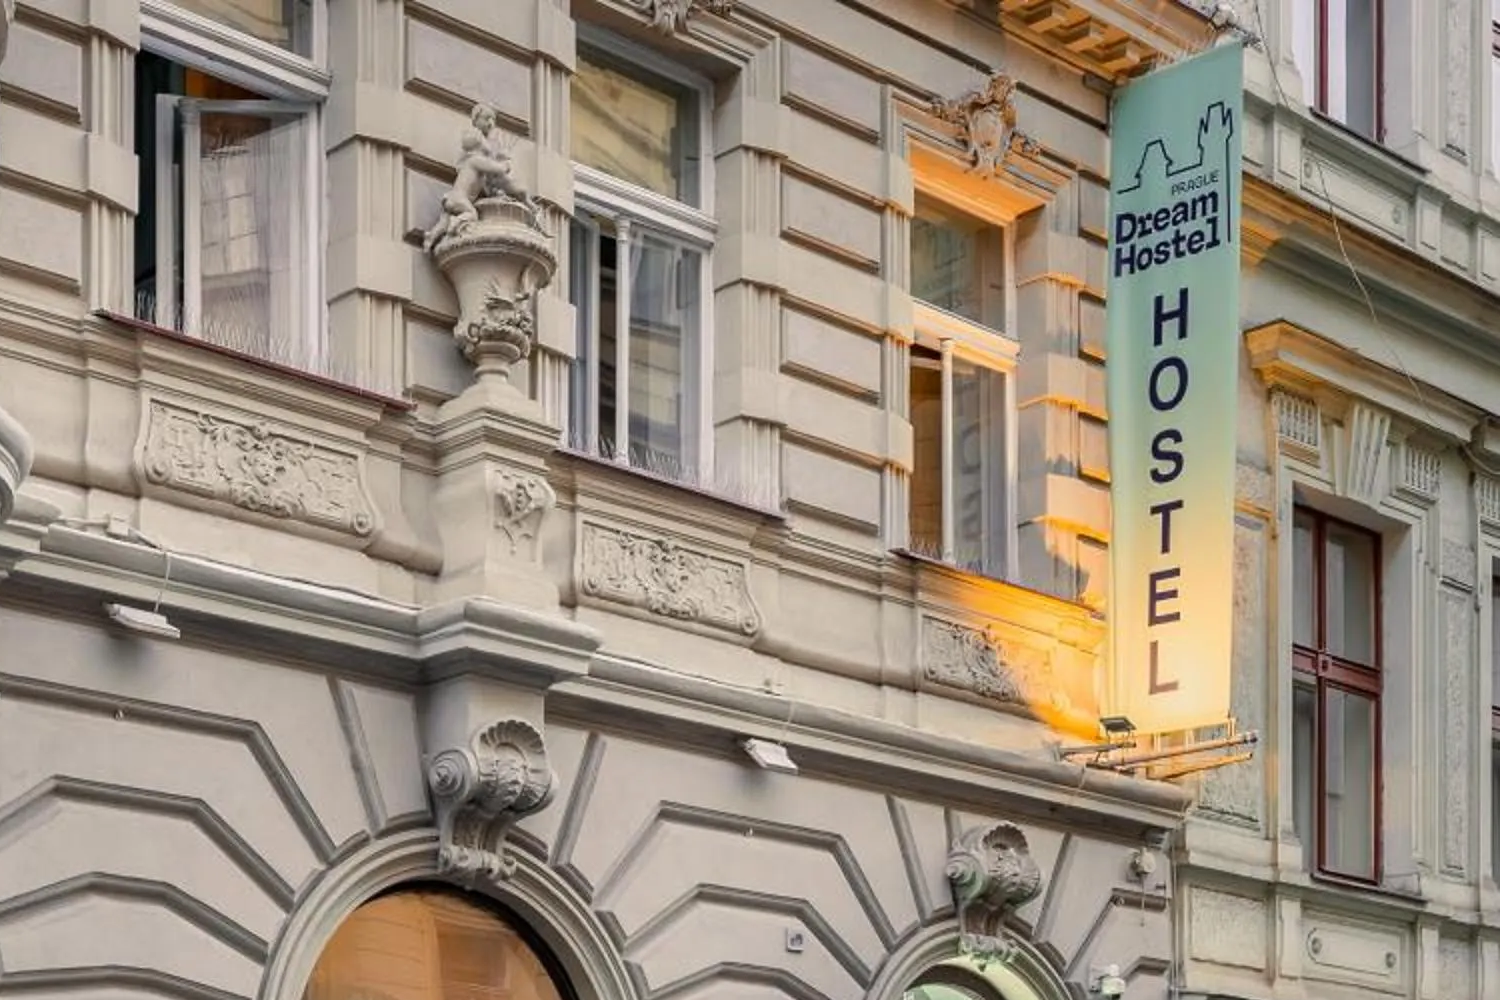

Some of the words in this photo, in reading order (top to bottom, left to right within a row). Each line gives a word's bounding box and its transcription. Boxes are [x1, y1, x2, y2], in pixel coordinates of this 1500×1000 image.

[1114, 216, 1221, 277] Hostel
[1116, 191, 1218, 244] Dream
[1148, 287, 1189, 695] HOSTEL
